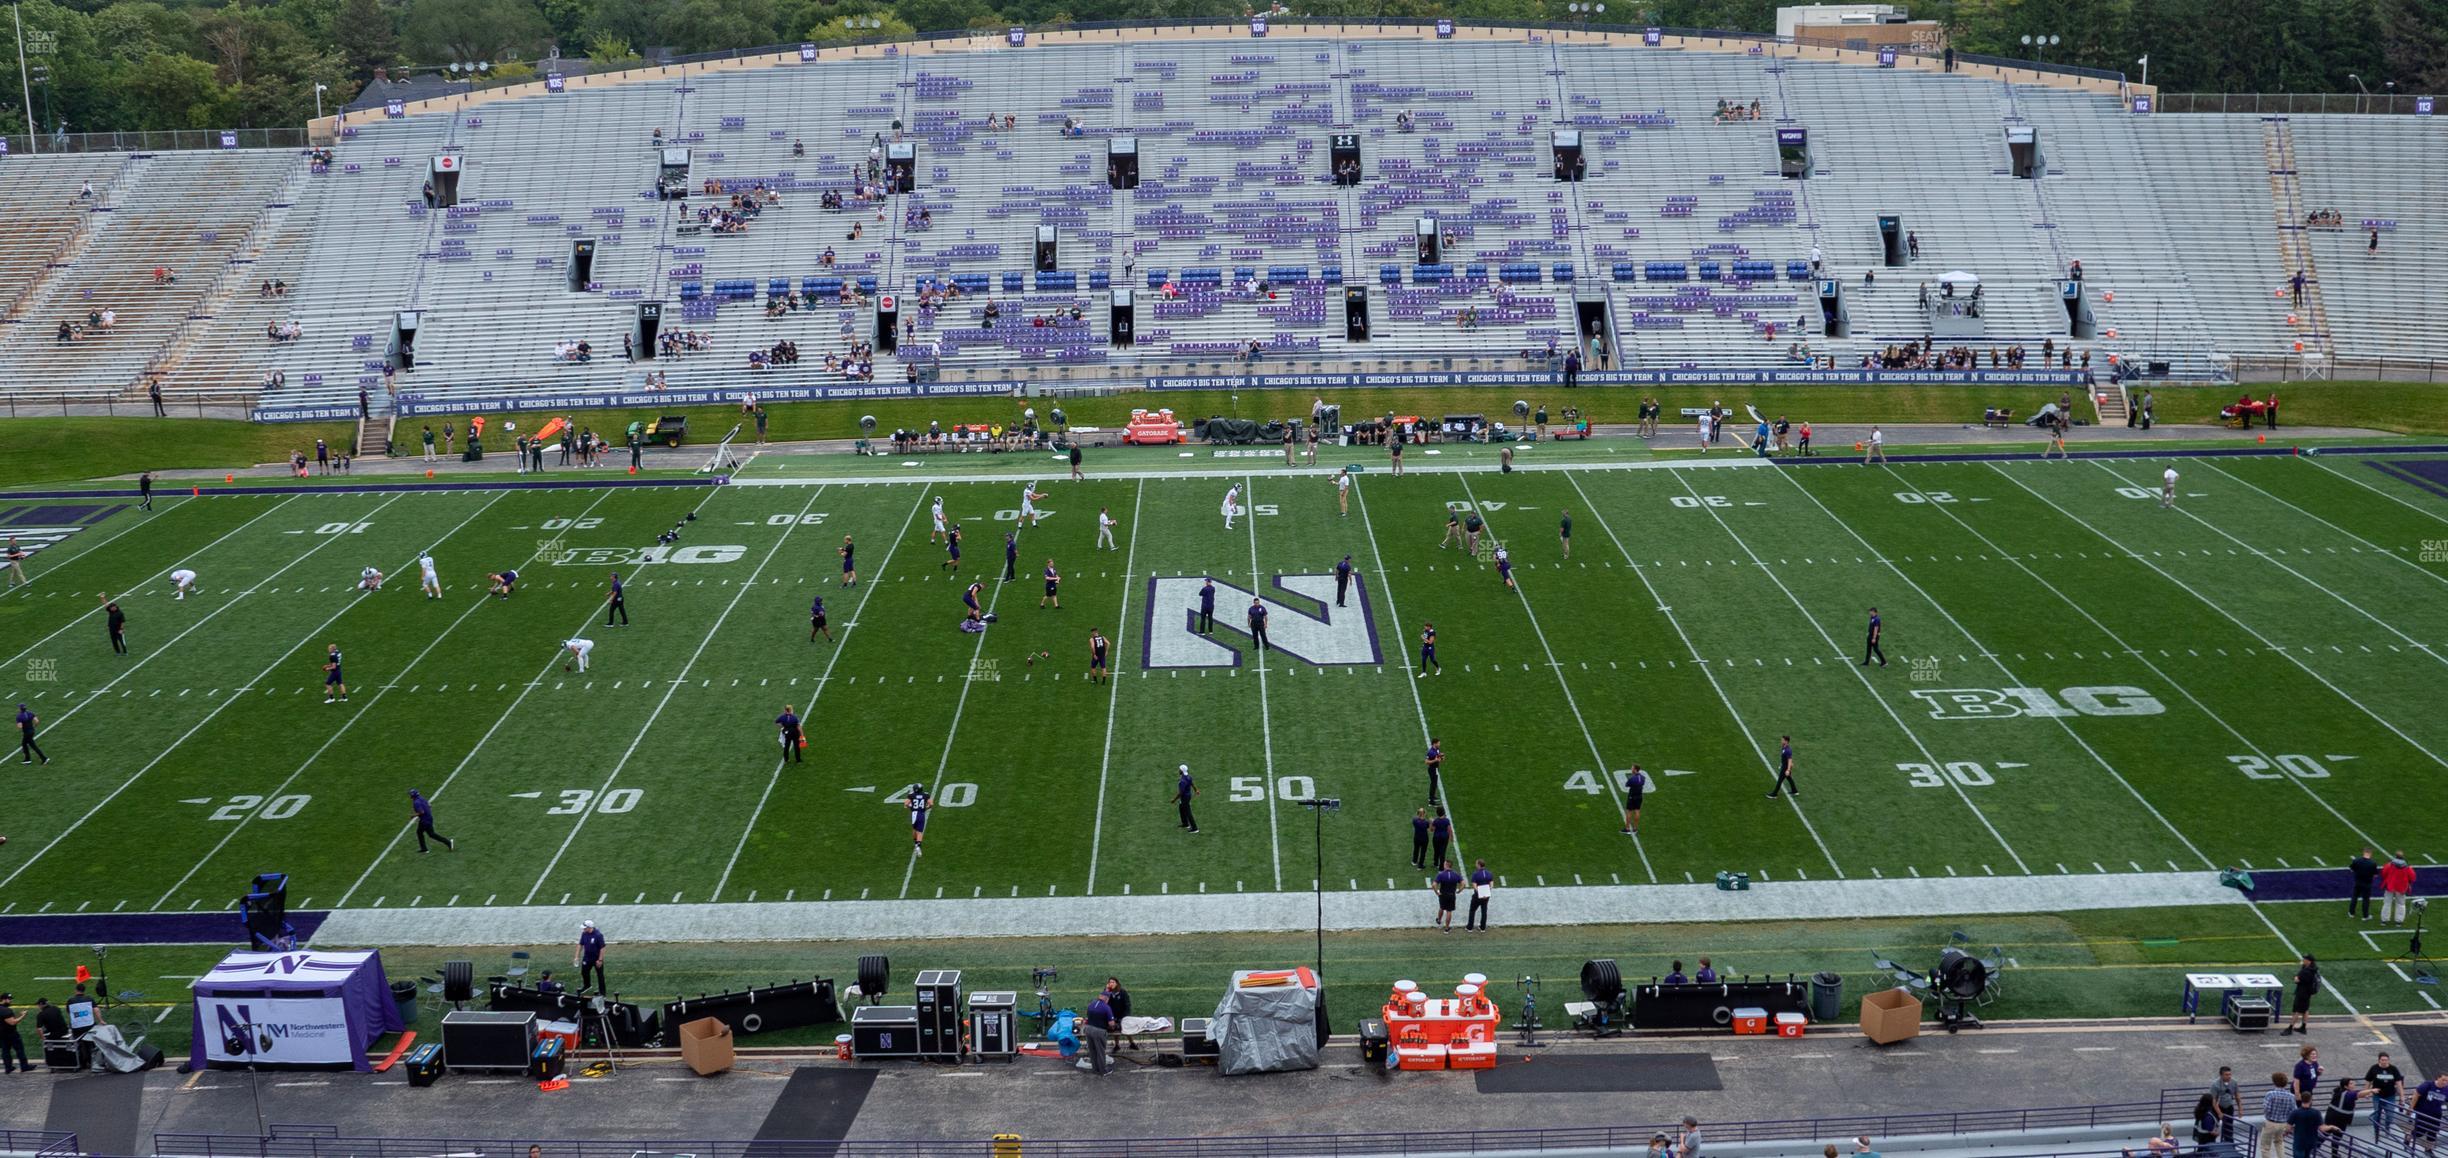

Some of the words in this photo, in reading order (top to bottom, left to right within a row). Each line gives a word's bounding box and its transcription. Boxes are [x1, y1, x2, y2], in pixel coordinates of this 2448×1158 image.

[1252, 23, 1264, 32] 108
[1438, 24, 1450, 33] 109
[1010, 33, 1023, 42] 107
[1648, 32, 1659, 41] 110
[802, 49, 815, 58] 106
[1882, 53, 1893, 62] 111
[549, 78, 562, 87] 105
[389, 105, 401, 114] 104
[2136, 100, 2148, 110] 112
[2418, 102, 2431, 112] 113
[222, 136, 235, 145] 103
[1252, 377, 1258, 386] N
[1264, 377, 1299, 385] CHICAGO'S
[1353, 376, 1359, 384] N
[1429, 375, 1448, 383] TEAM
[1455, 374, 1461, 383] N
[1516, 374, 1530, 382] TEN
[1531, 374, 1550, 382] TEAM
[1557, 374, 1563, 382] N
[1634, 373, 1653, 381] TEAM
[1659, 373, 1665, 381] N
[1763, 372, 1769, 381] N
[1866, 372, 1873, 381] N
[1971, 372, 1978, 381] N
[1984, 373, 2020, 381] CHICAGO'S
[2022, 373, 2034, 381] BIG
[2035, 373, 2049, 381] TEN
[2051, 373, 2070, 381] TEAM
[1150, 379, 1156, 387] N
[1163, 379, 1197, 387] CHICAGO'S
[1226, 378, 1245, 386] TEAM
[816, 388, 822, 397] N
[828, 388, 863, 396] CHICAGO'S
[892, 386, 911, 394] TEAM
[917, 385, 923, 394] N
[929, 385, 964, 393] CHICAGO'S
[978, 384, 991, 392] TEN
[993, 384, 1012, 392] TEAM
[610, 396, 617, 405] N
[623, 394, 658, 404] CHICAGO'S
[673, 394, 686, 402] TEN
[713, 392, 720, 401] N
[775, 390, 789, 398] TEN
[402, 405, 408, 414] N
[414, 404, 451, 413] CHICAGO'S
[452, 403, 464, 411] BIG
[480, 402, 500, 410] TEAM
[506, 400, 513, 409] N
[519, 399, 555, 408] CHICAGO'S
[569, 398, 583, 406] TEN
[254, 412, 261, 421] N
[263, 411, 300, 420] CHICAGO'S
[301, 410, 314, 418] BIG
[331, 409, 350, 417] TEAM
[353, 408, 359, 416] N
[1669, 495, 1733, 508] 30
[1894, 491, 1959, 504] 20
[1446, 500, 1507, 512] 40
[540, 517, 605, 530] 20
[766, 513, 830, 525] 30
[314, 522, 375, 534] 10
[1141, 572, 1384, 670] N
[2226, 754, 2332, 780] 20
[1896, 762, 1995, 788] 30
[1563, 769, 1656, 795] 40
[1230, 776, 1315, 802] 50
[547, 789, 645, 815] 30
[912, 799, 925, 809] 34
[208, 795, 313, 820] 20
[263, 954, 311, 975] N
[1464, 998, 1472, 1006] G
[290, 1023, 345, 1031] Northwestern
[1747, 1019, 1755, 1027] G
[216, 1004, 257, 1055] N
[1465, 1024, 1485, 1042] G
[1786, 1025, 1796, 1035] G
[880, 1032, 892, 1049] N
